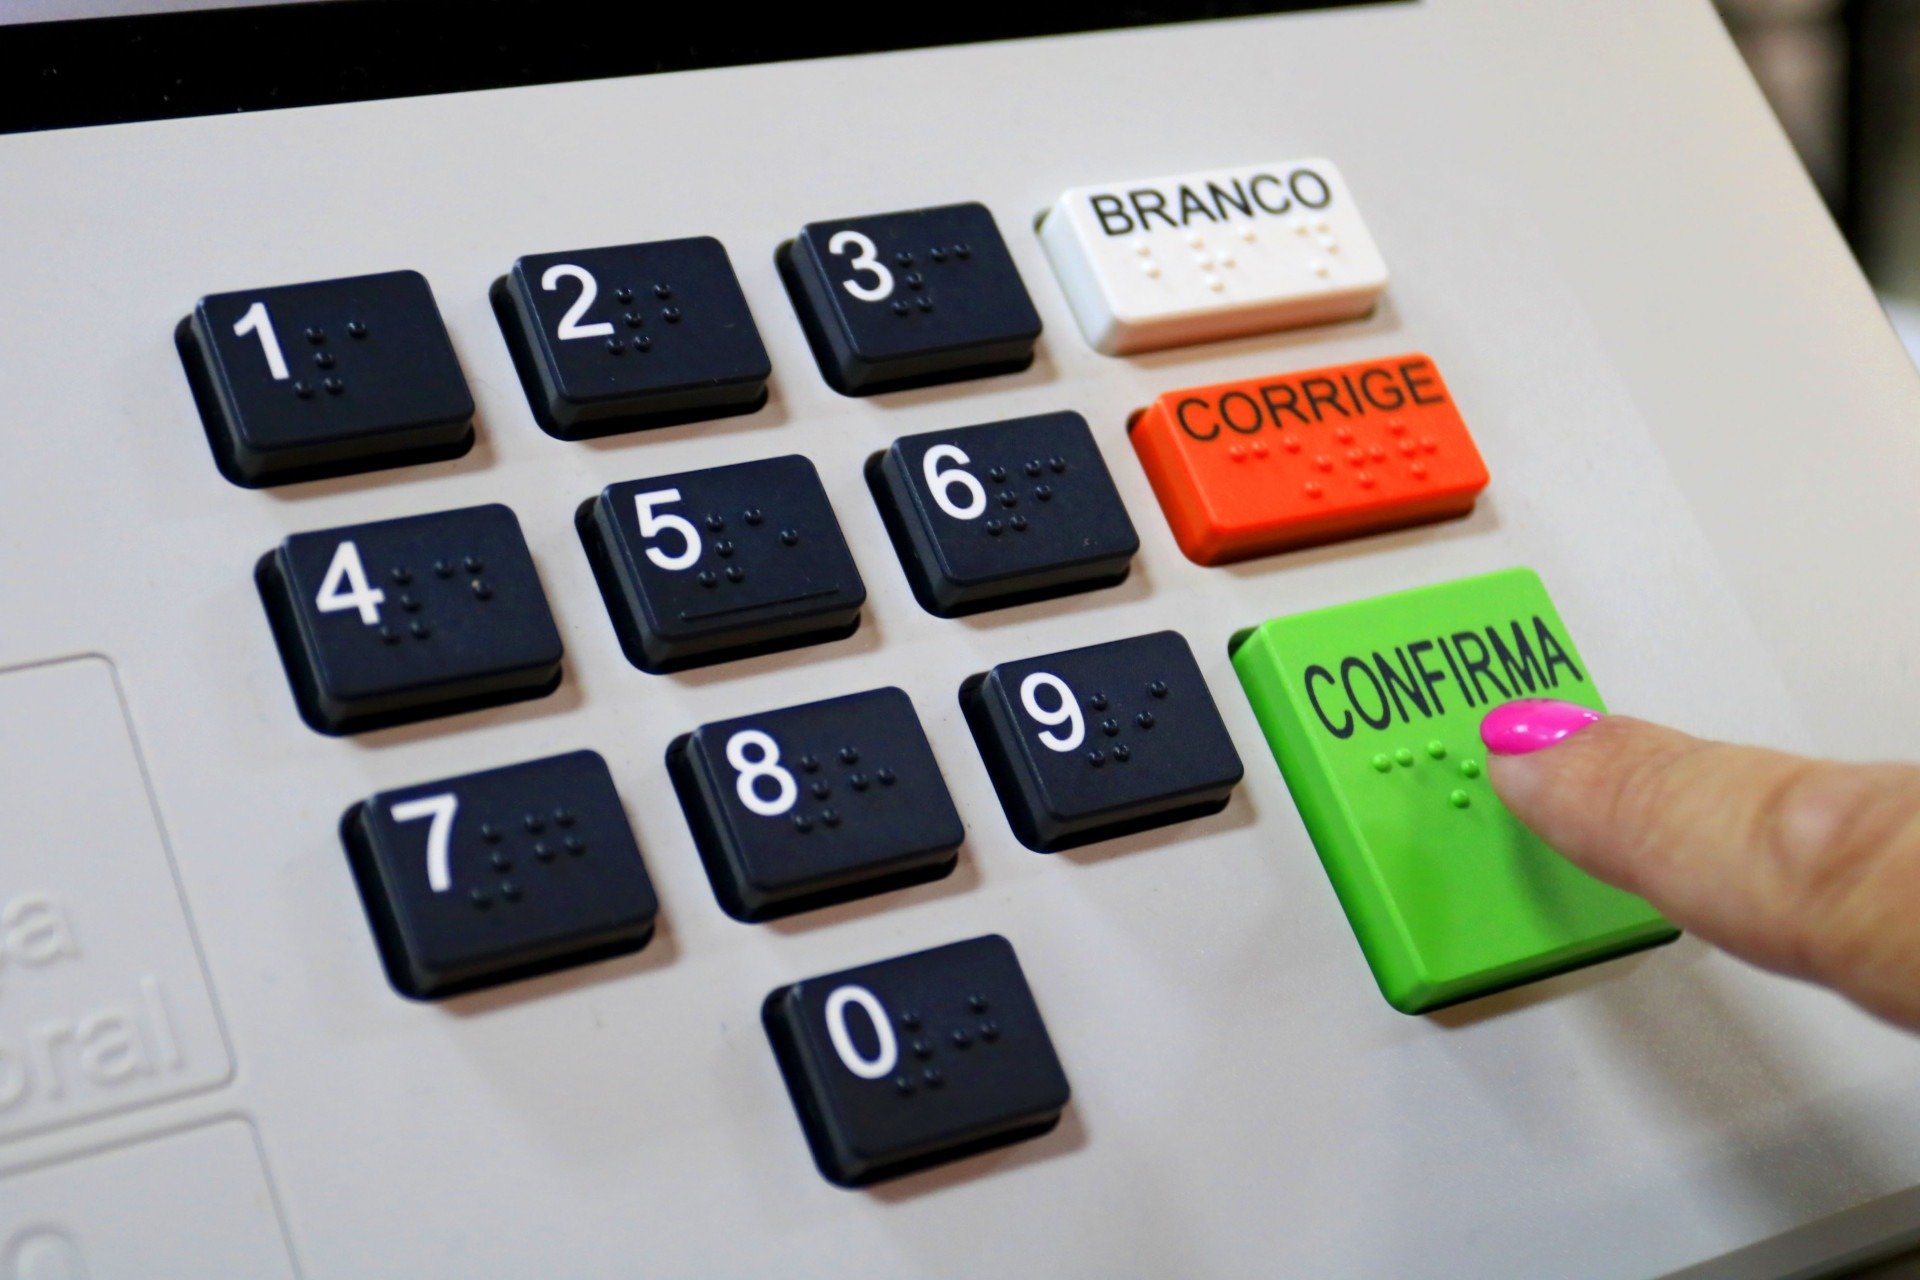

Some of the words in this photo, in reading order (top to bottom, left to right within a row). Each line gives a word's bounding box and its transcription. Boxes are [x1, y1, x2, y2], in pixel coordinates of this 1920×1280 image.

[1089, 168, 1332, 236] BRANCO
[542, 263, 614, 341] 2
[829, 230, 894, 302] 3
[233, 302, 290, 380] 1
[1175, 360, 1446, 442] CORRIGE
[922, 443, 987, 520] 6
[635, 488, 702, 571] 5
[315, 541, 385, 625] 4
[1020, 671, 1086, 753] 9
[1304, 615, 1584, 740] CONFIRMA
[725, 729, 798, 816] 8
[391, 793, 458, 892] 7
[825, 985, 898, 1079] 0
